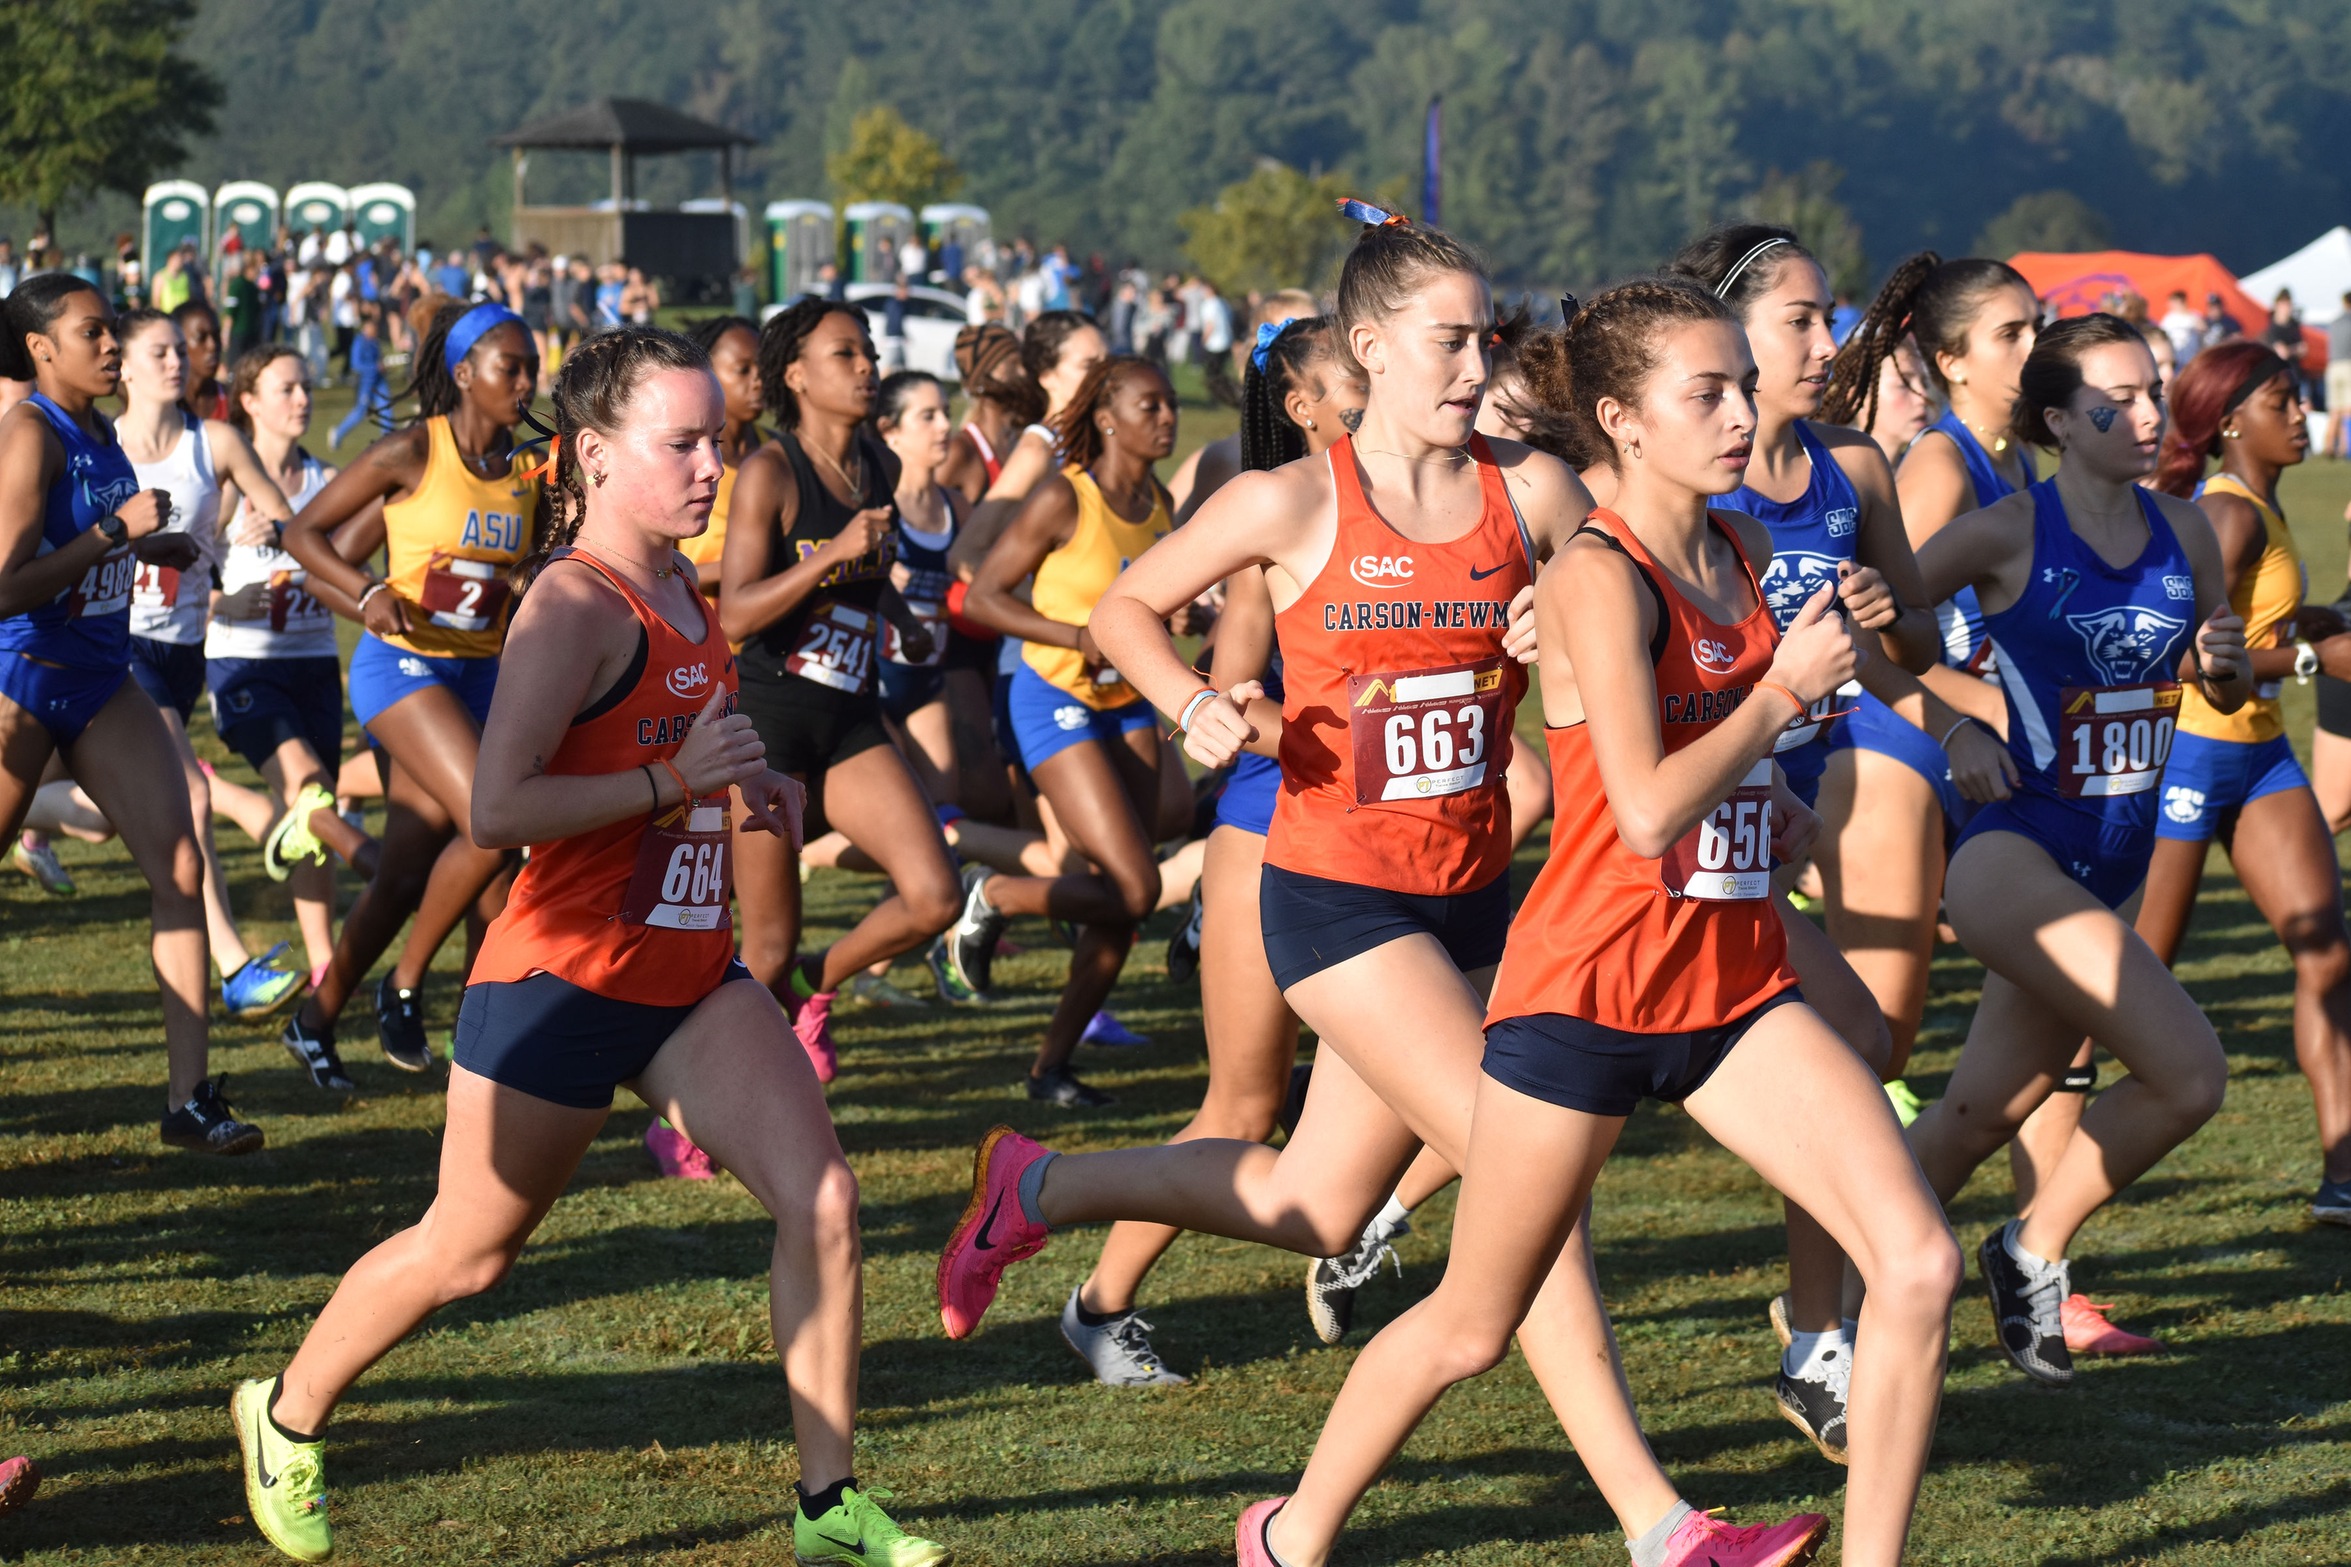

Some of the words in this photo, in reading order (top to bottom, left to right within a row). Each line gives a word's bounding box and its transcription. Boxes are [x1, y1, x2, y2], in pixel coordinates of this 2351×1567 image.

[460, 508, 523, 553] ASU
[78, 551, 137, 600] 4988
[1358, 555, 1415, 579] SAC
[455, 580, 484, 617] 2
[797, 622, 872, 678] 2541
[1697, 638, 1734, 663] SAC
[675, 662, 709, 690] SAC
[1384, 704, 1485, 775] 663
[2072, 716, 2174, 774] 1800
[1697, 800, 1772, 870] 656
[661, 843, 724, 905] 664
